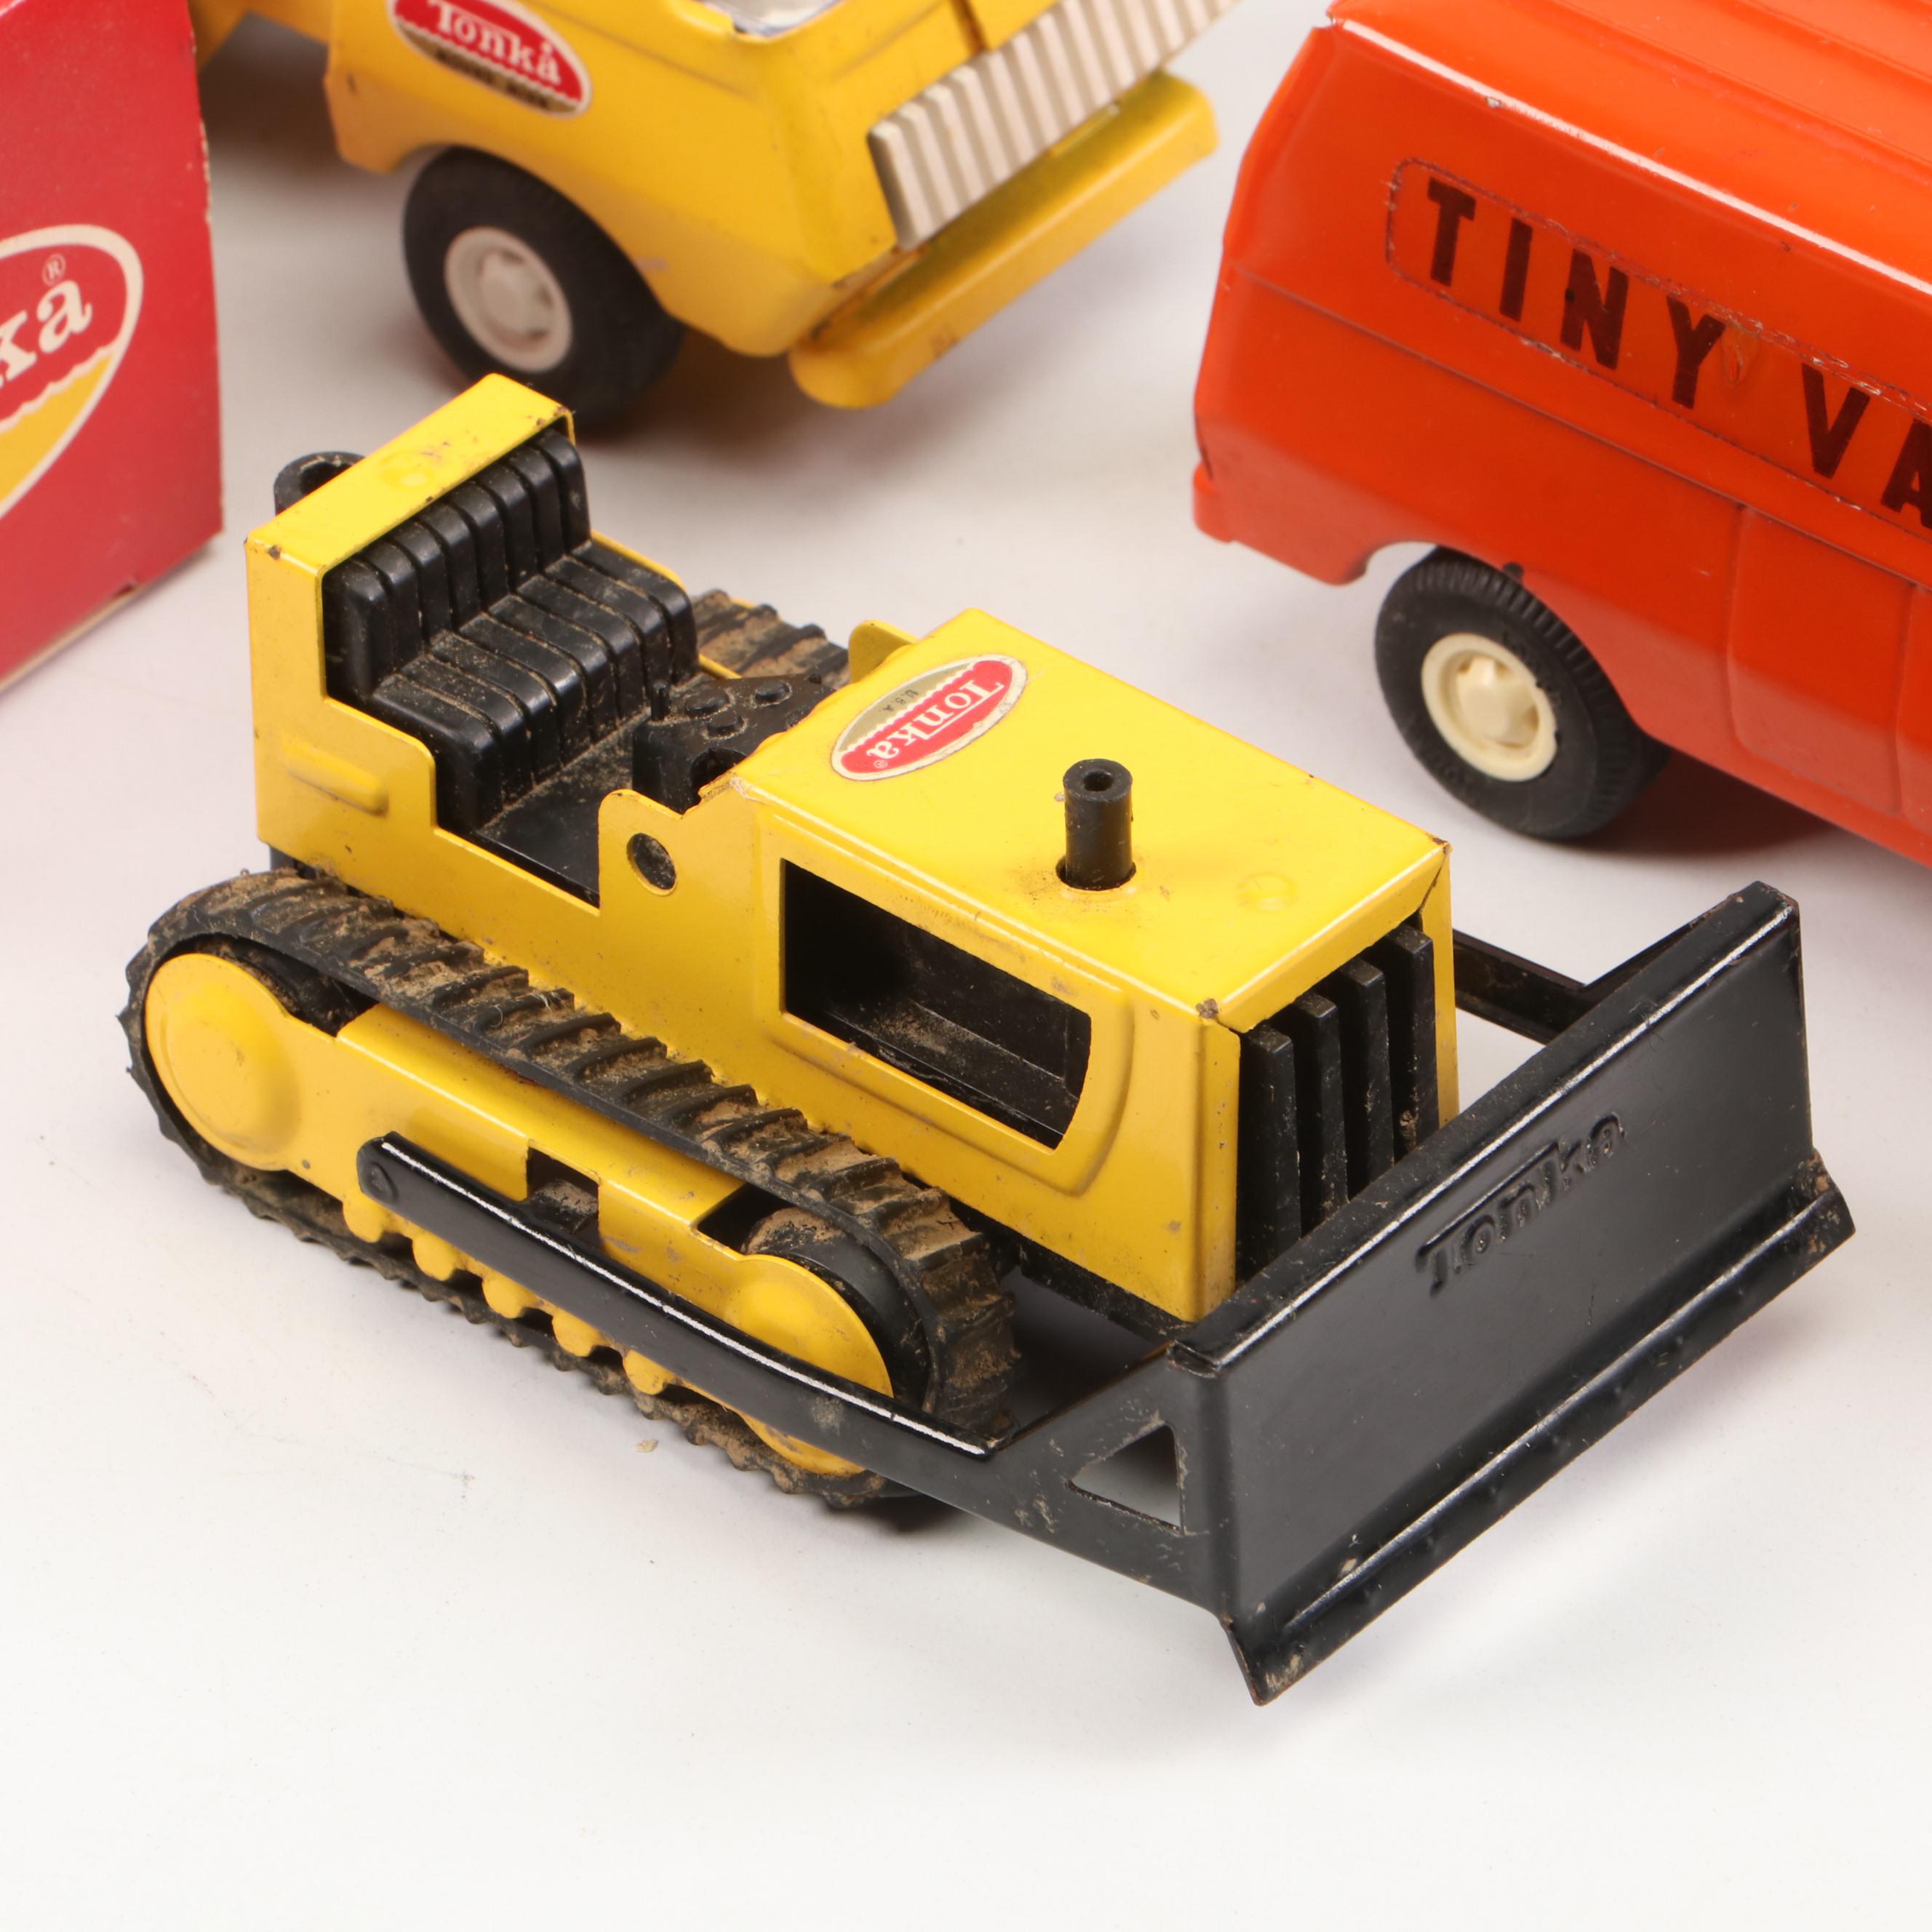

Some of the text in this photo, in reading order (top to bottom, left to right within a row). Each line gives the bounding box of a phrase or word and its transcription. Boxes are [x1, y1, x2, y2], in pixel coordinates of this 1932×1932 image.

[428, 0, 561, 85] Tonka
[1427, 177, 1725, 410] TINY
[866, 679, 1005, 759] Tonka
[1415, 1112, 1626, 1297] Tonka
